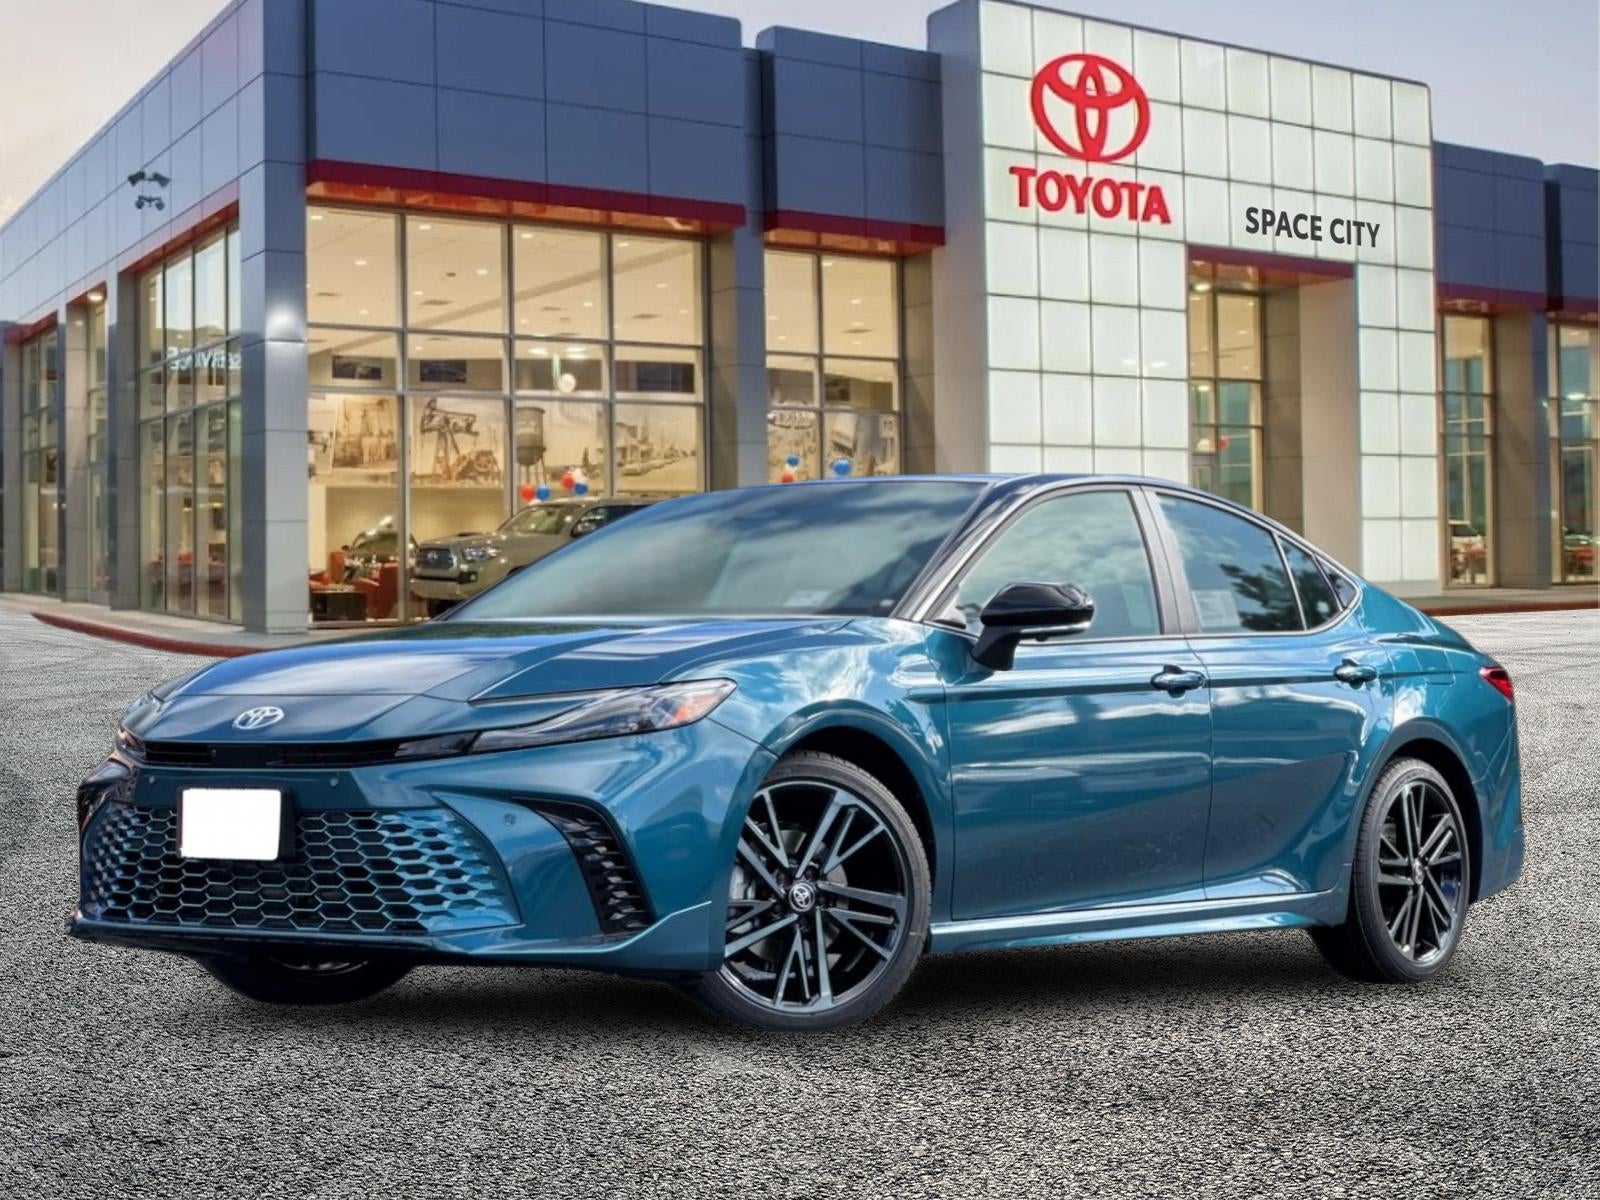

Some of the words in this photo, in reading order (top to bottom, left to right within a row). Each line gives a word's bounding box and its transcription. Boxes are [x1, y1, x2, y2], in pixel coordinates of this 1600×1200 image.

[1010, 166, 1171, 224] TOYOTA
[1245, 206, 1323, 242] SPACE
[1329, 218, 1380, 248] CITY
